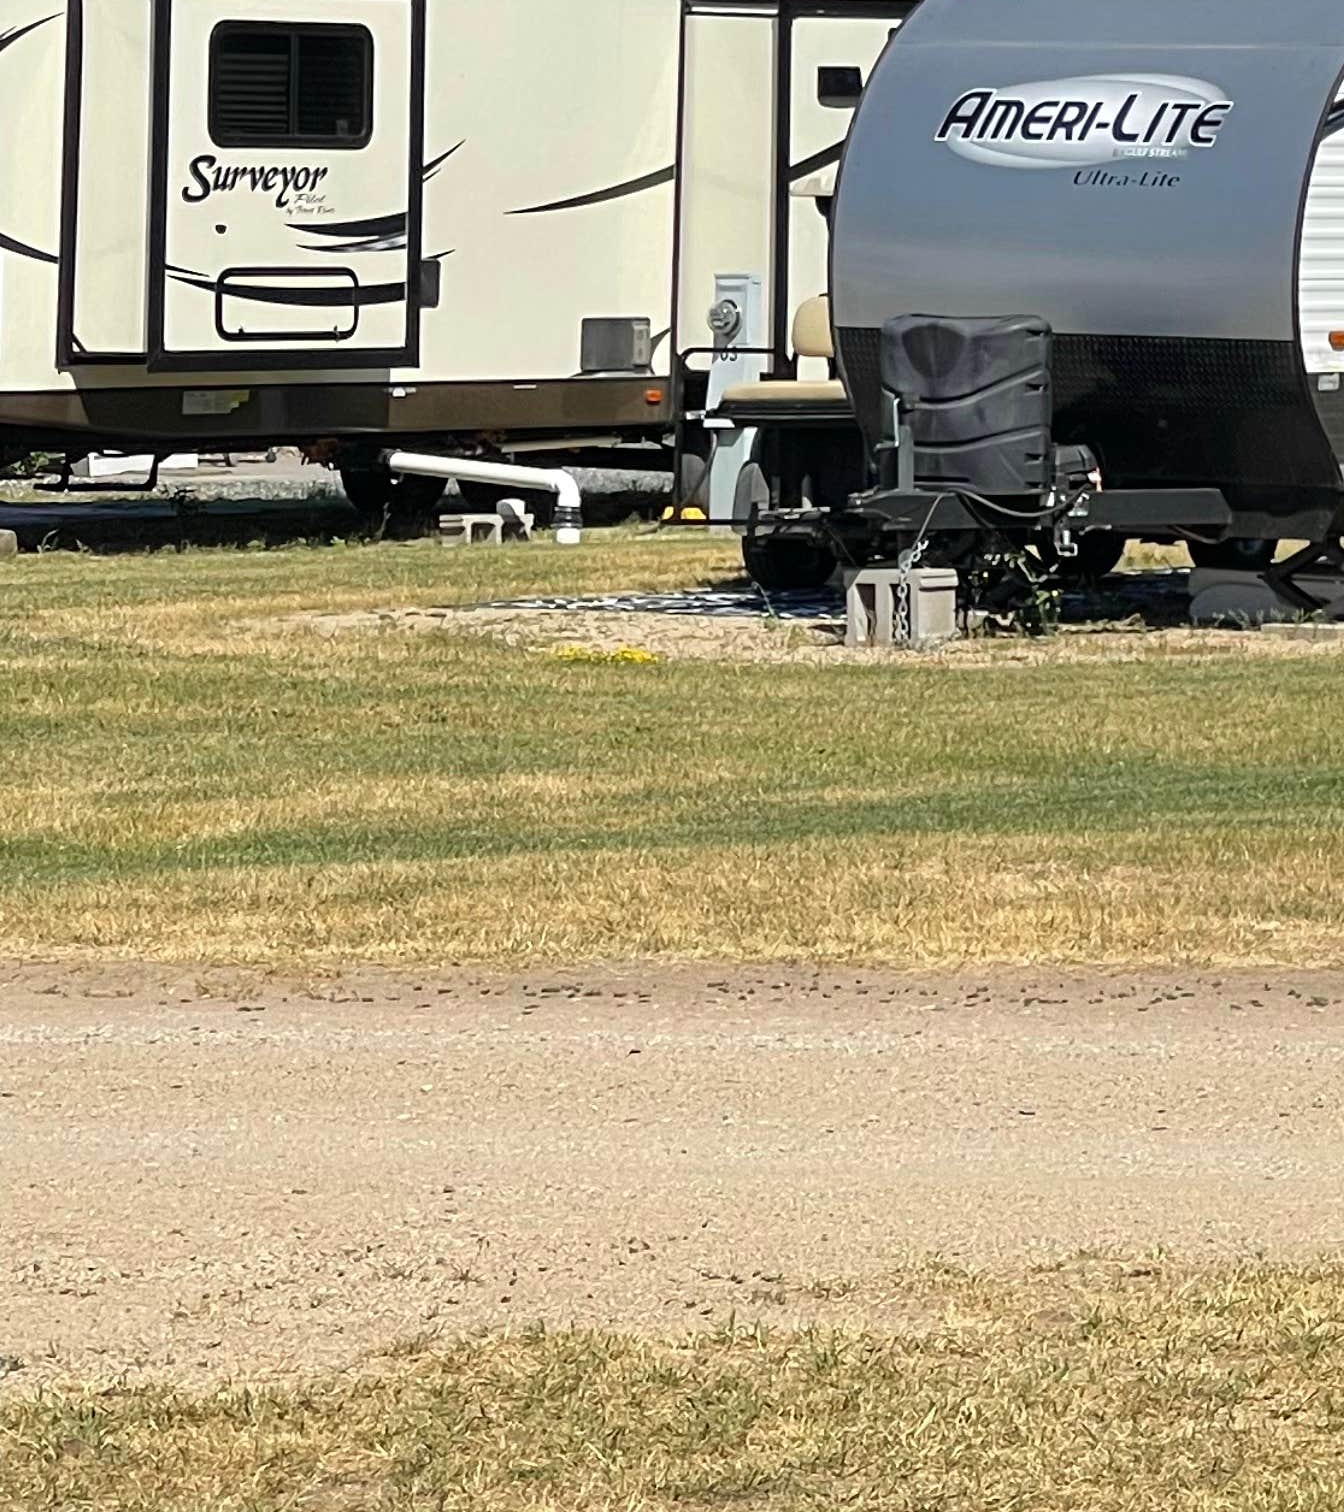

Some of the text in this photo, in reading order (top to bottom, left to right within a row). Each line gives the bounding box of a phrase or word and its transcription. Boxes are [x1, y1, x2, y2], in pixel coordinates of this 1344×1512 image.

[935, 88, 1232, 146] AMERI-LITE
[182, 154, 328, 208] Surveyor
[1073, 169, 1181, 188] Ultra-Lite
